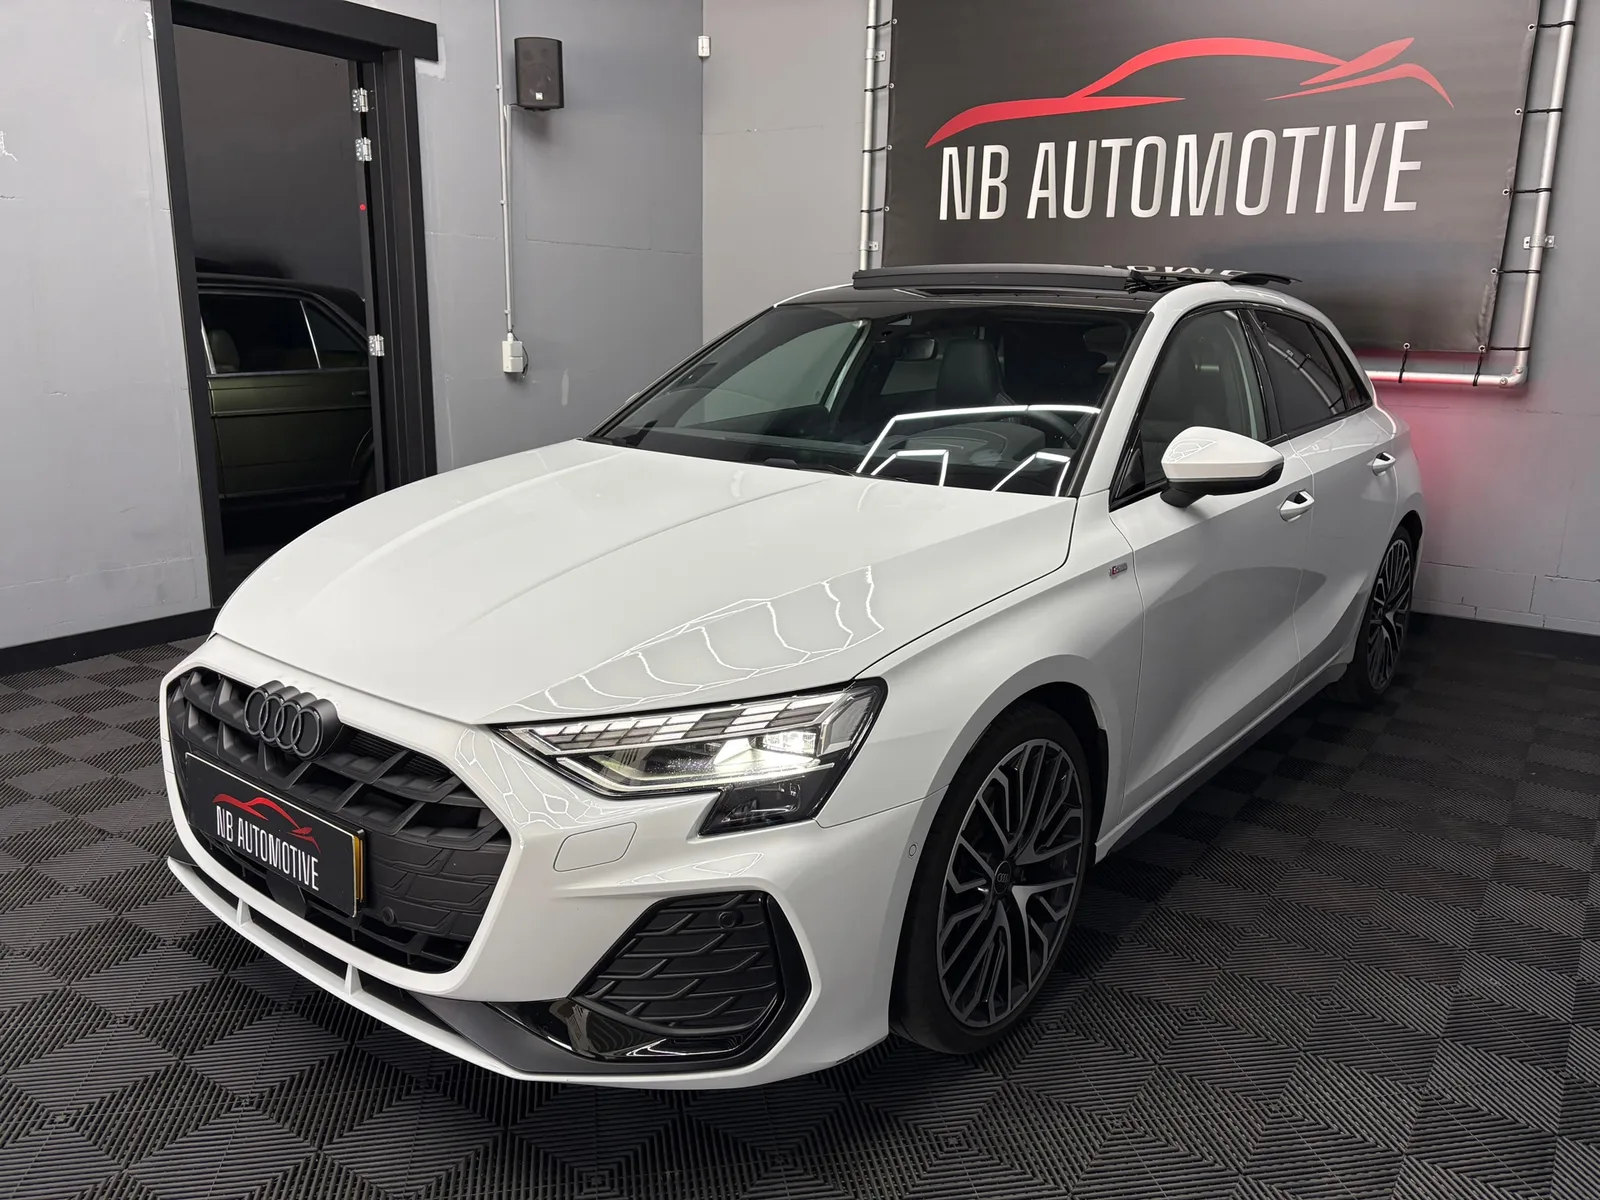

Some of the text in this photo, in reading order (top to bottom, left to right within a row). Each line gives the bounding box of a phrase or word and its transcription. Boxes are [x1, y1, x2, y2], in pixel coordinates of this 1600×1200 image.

[939, 120, 1429, 220] NB AUTOMOTIVE
[216, 805, 319, 891] NB AUTOMOTIVE
